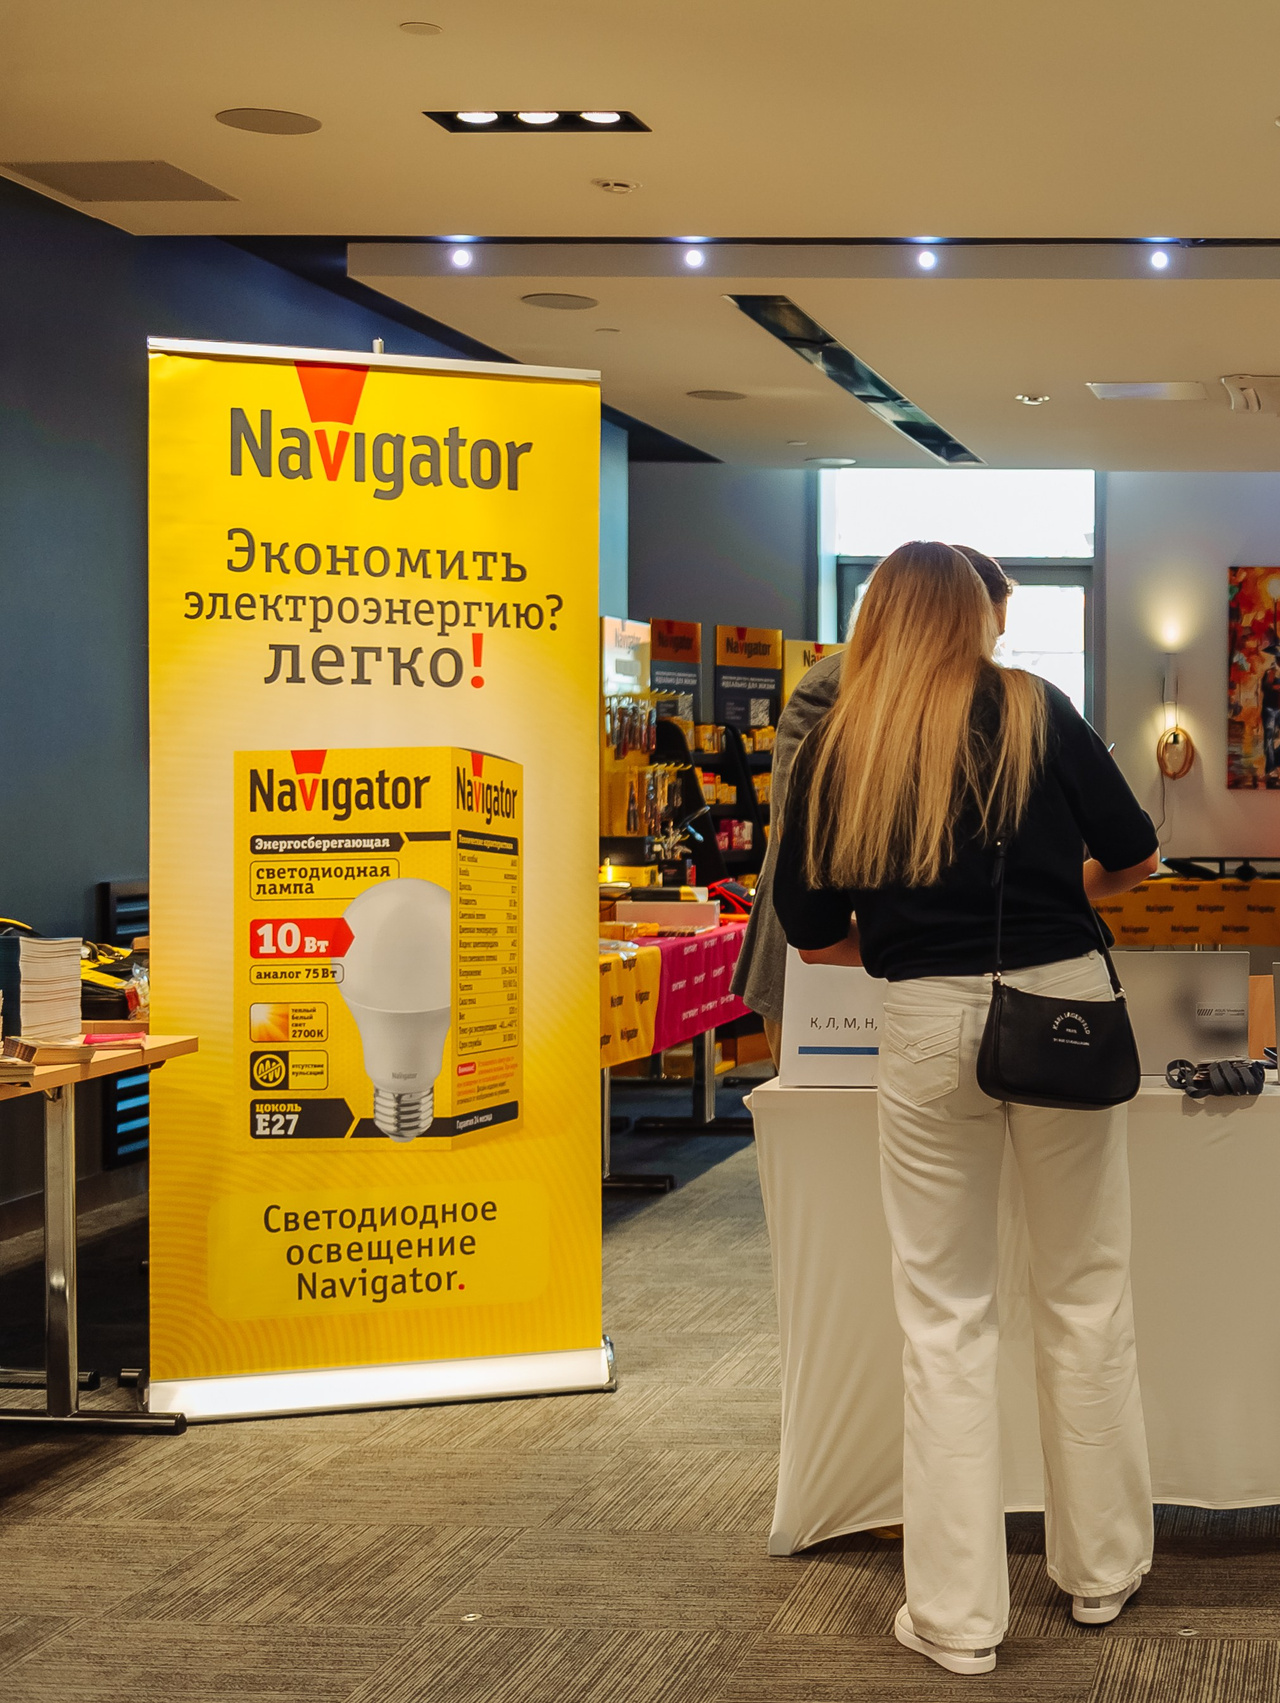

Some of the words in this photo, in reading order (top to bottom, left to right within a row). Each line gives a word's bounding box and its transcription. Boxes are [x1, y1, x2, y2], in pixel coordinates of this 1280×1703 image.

[230, 406, 533, 501] Navigator
[226, 527, 528, 583] Экономить
[184, 589, 564, 637] электроэнергию?
[264, 632, 485, 689] легко!
[726, 637, 771, 659] Navigator
[249, 768, 431, 821] Navigator
[456, 765, 518, 826] Navigator
[255, 836, 391, 853] Энергосберегающая
[255, 864, 391, 881] светодиодная
[255, 881, 315, 896] лампа
[256, 922, 302, 954] 10
[303, 936, 329, 953] Вт
[255, 970, 302, 979] аналог
[304, 968, 320, 979] 75
[321, 968, 338, 979] Вт
[291, 1029, 316, 1038] 2700
[810, 1017, 822, 1030] К,
[826, 1017, 839, 1030] Л,
[843, 1017, 860, 1030] М,
[865, 1017, 878, 1031] Н,
[255, 1103, 303, 1114] цоколь
[255, 1114, 300, 1136] E27
[263, 1200, 498, 1234] Светодиодное
[286, 1233, 477, 1266] освещение
[297, 1267, 466, 1303] Navigator.
